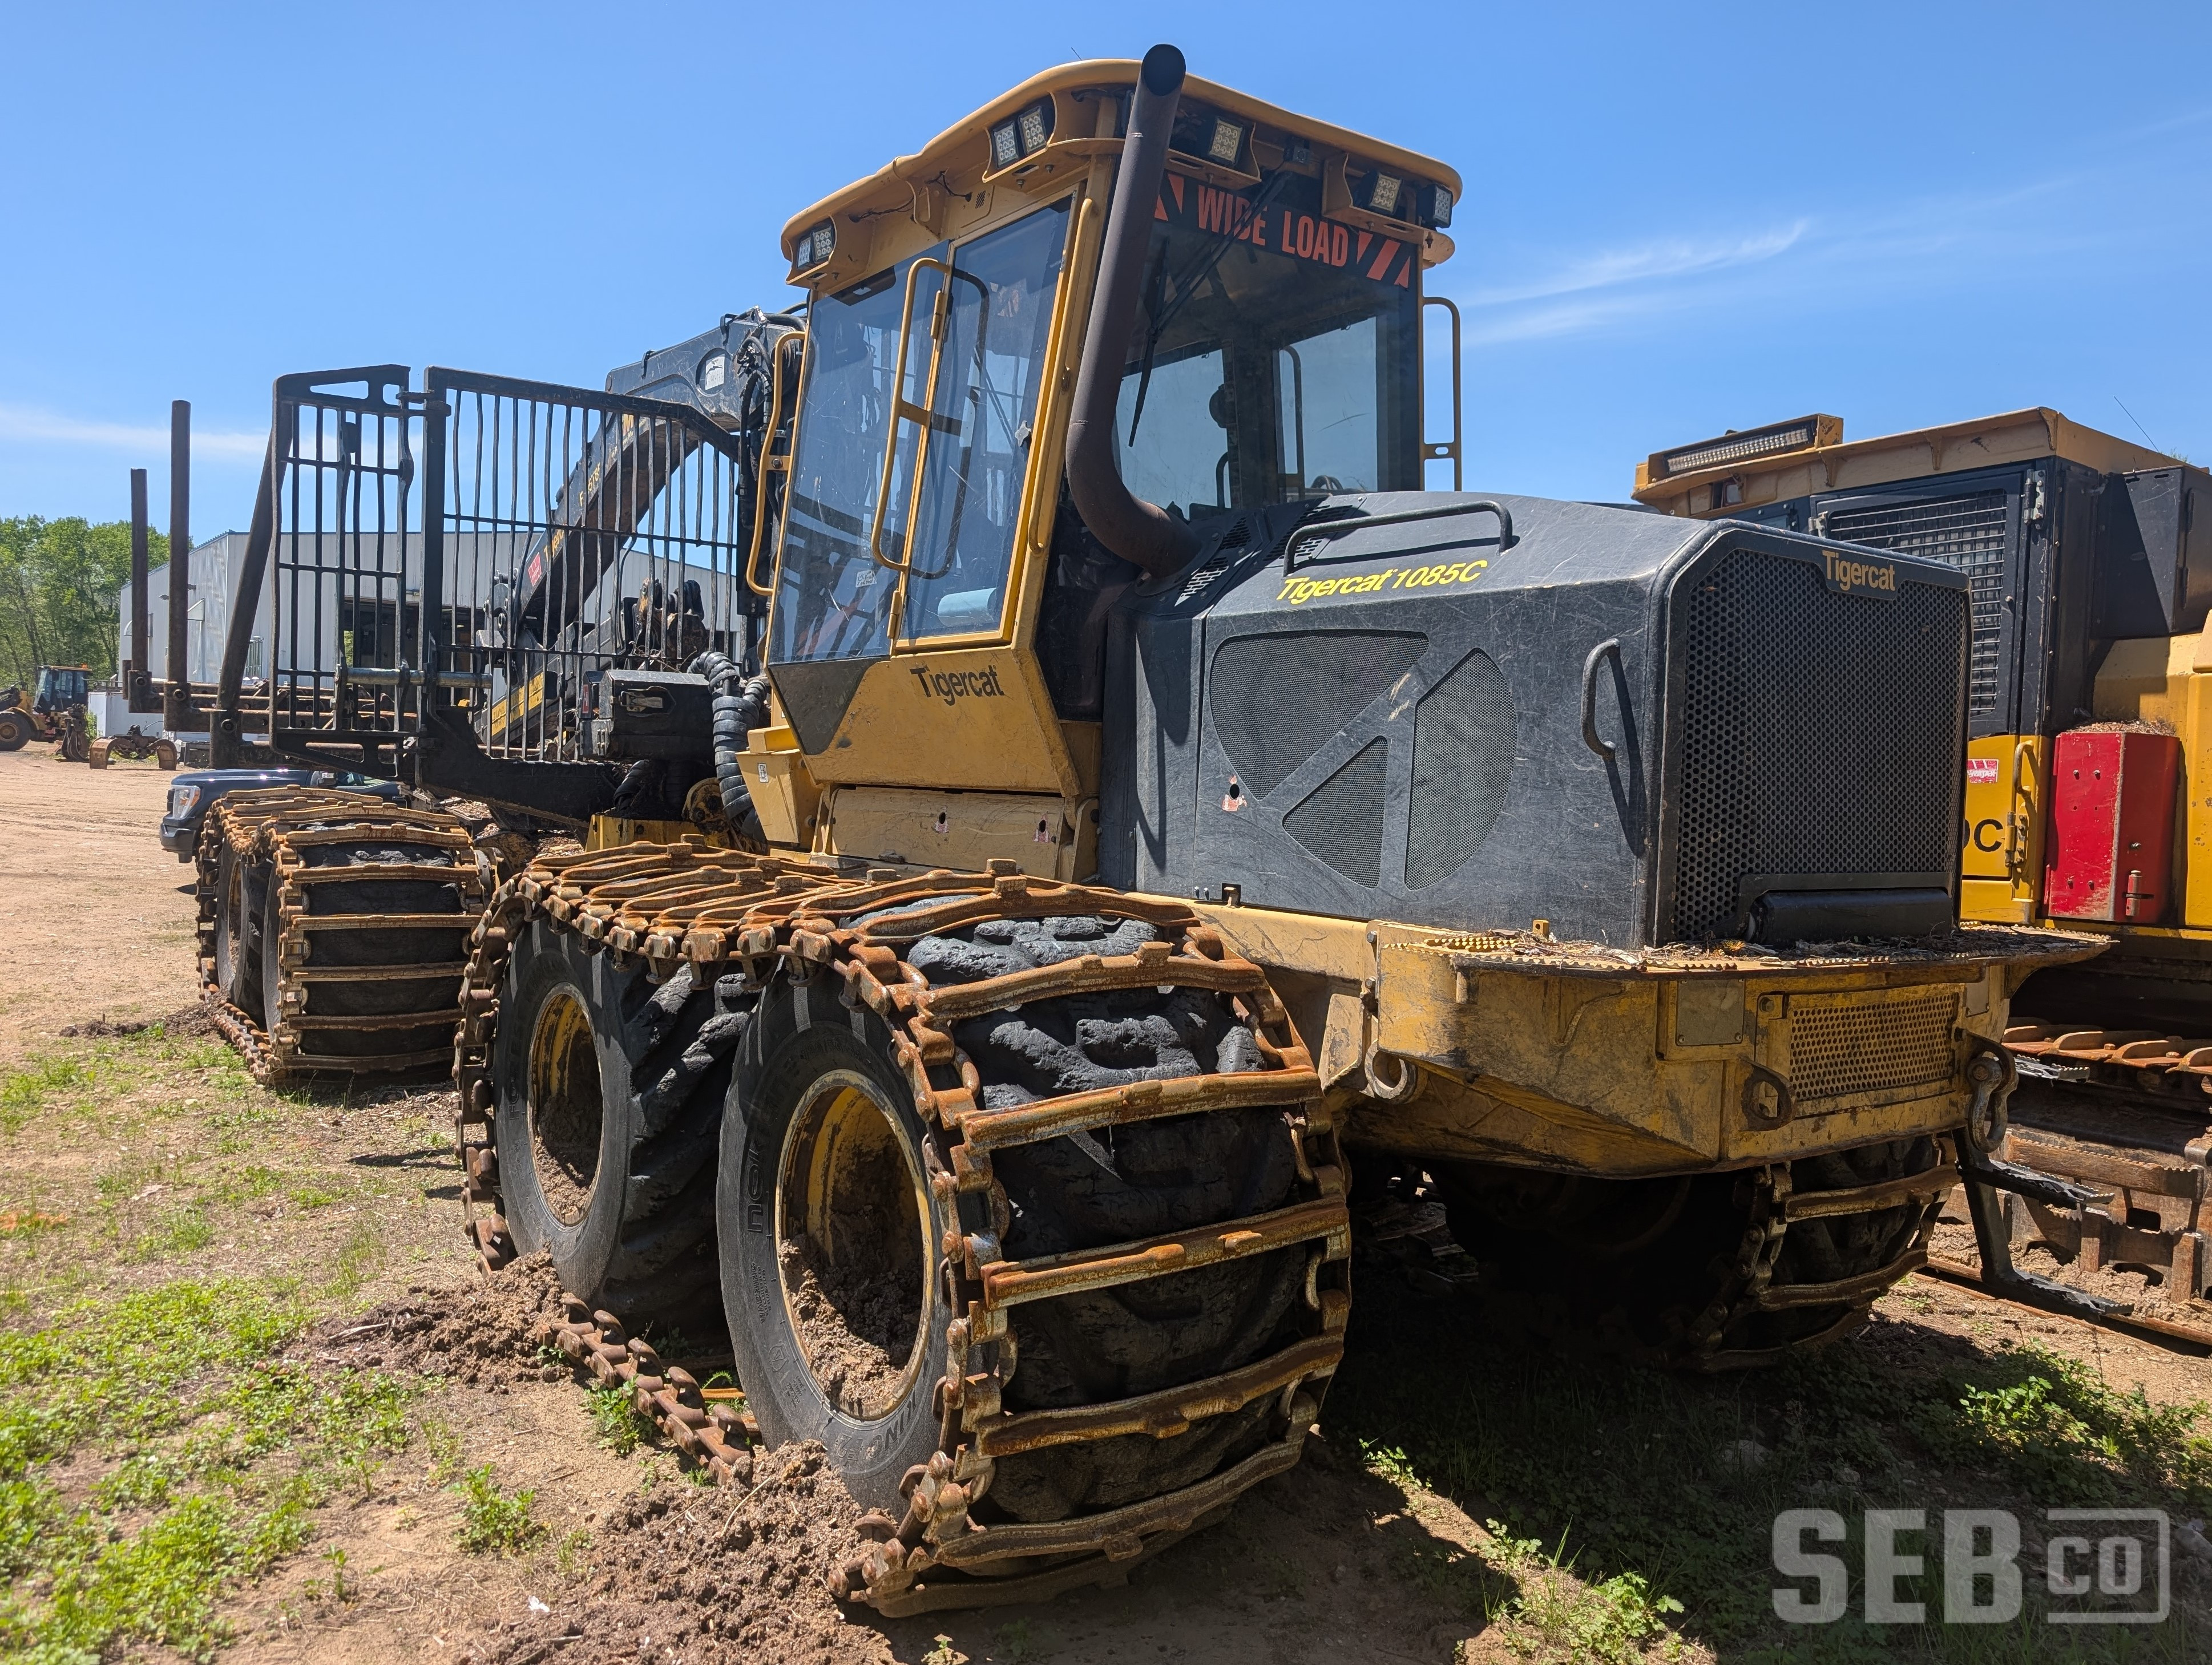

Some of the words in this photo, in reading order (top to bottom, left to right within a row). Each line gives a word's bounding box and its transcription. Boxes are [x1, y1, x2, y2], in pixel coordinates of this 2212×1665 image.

[1198, 185, 1268, 246] WIDE
[1282, 211, 1349, 267] LOAD
[1276, 569, 1394, 604] Tigercat
[1392, 560, 1488, 589] 1085C
[1822, 550, 1895, 591] Tigercat
[910, 665, 1005, 706] Tigercat
